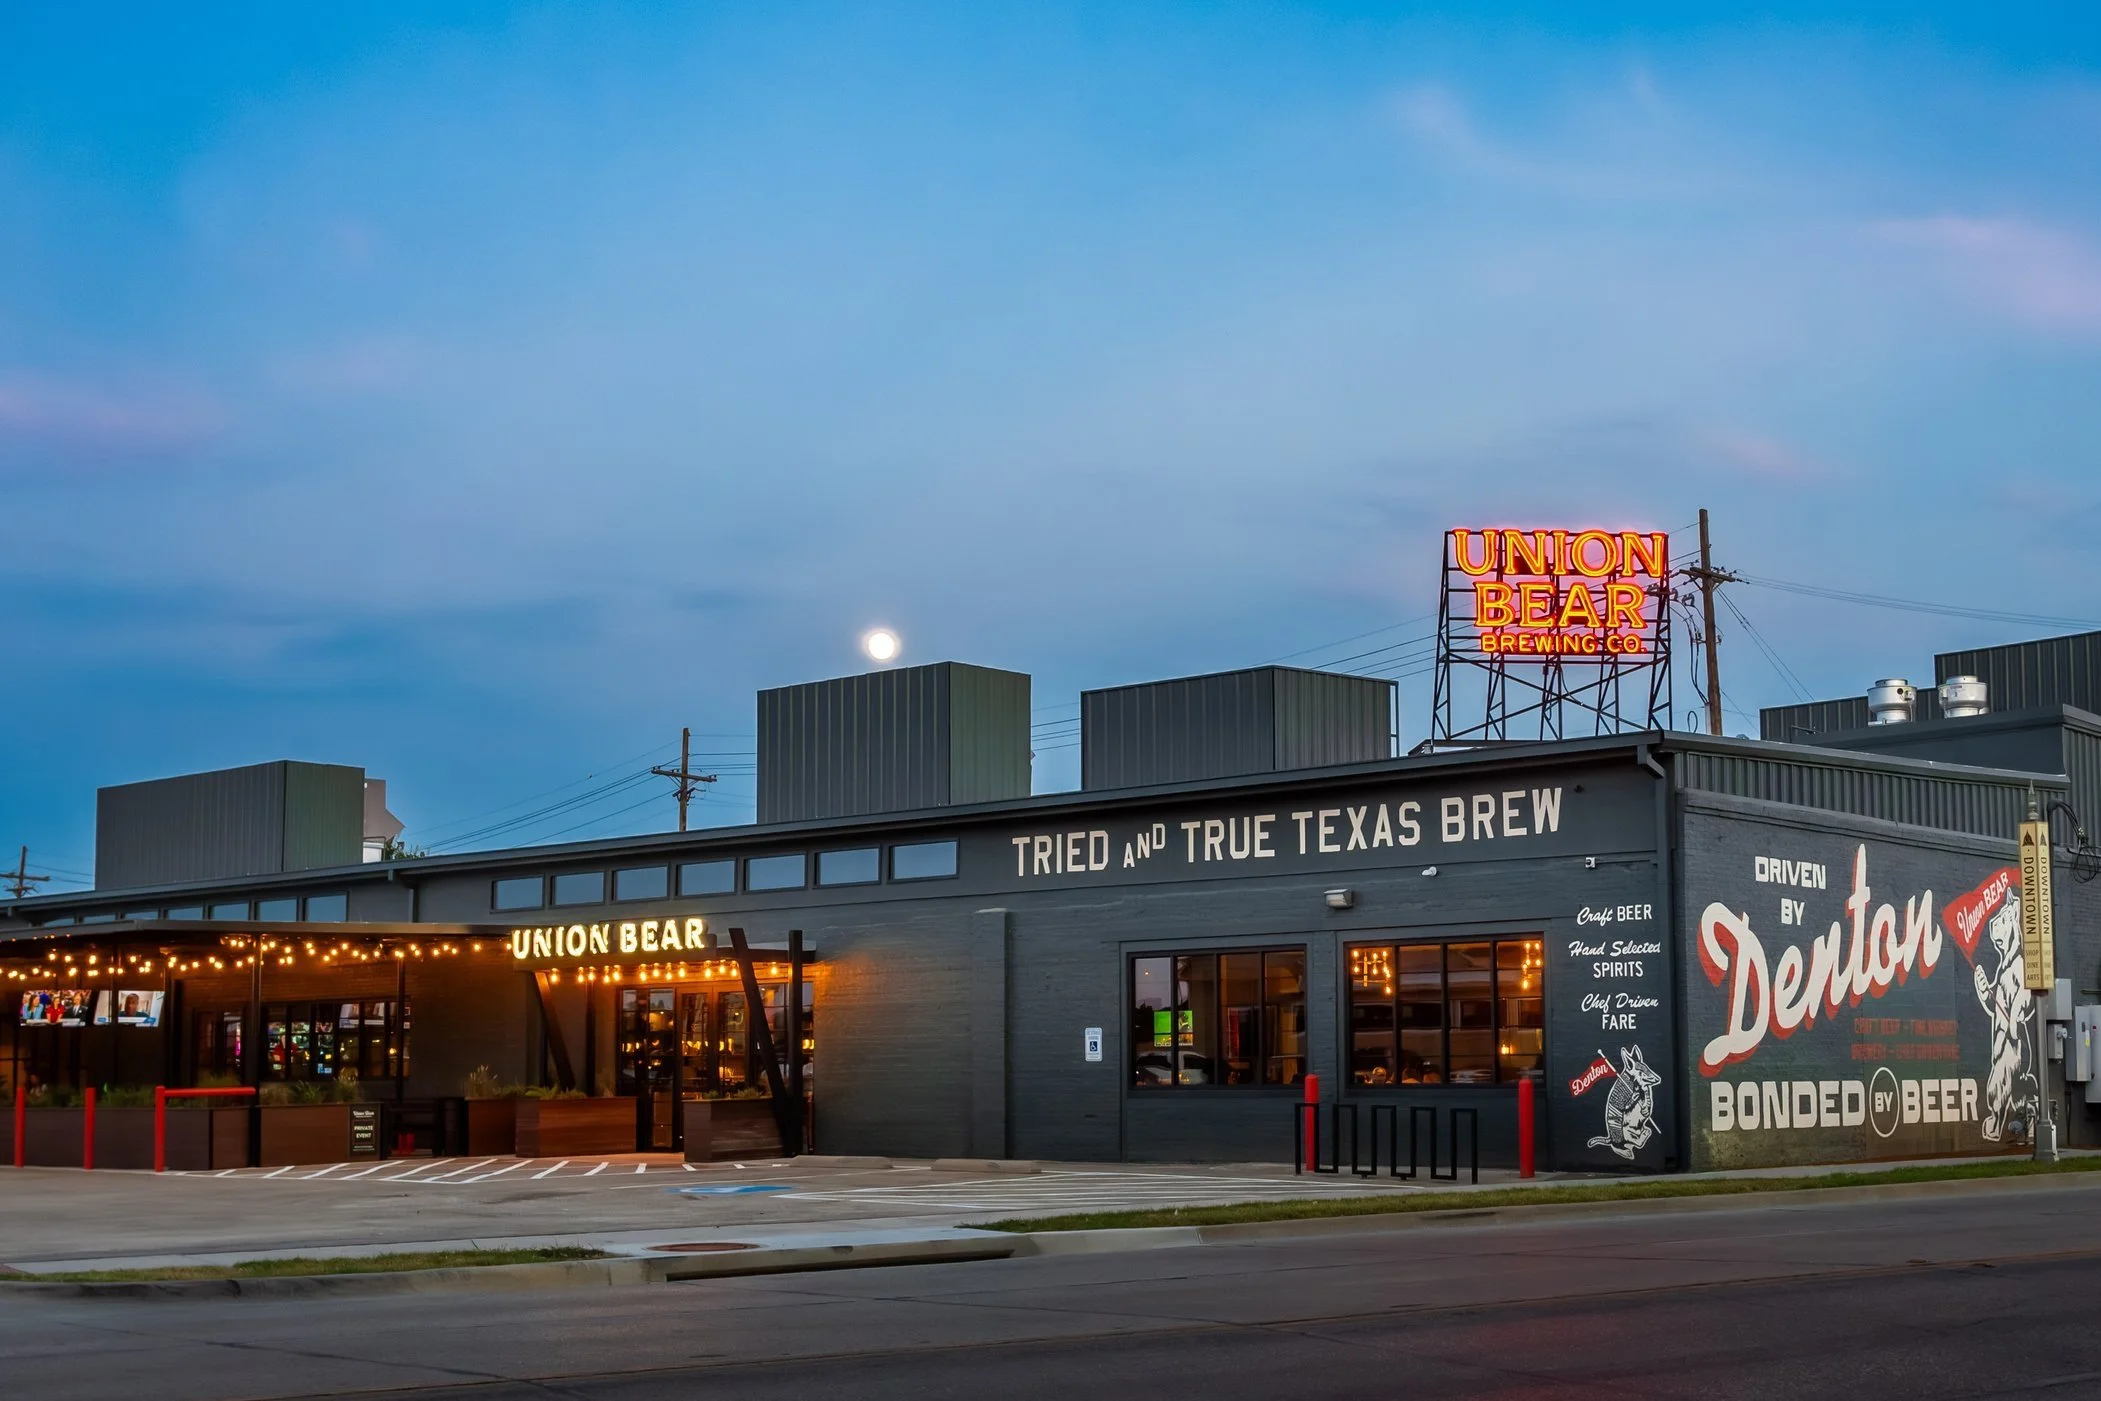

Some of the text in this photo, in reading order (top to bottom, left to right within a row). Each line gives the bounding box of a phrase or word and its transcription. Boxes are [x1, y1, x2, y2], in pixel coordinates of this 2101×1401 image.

[1452, 528, 1665, 577] UNION
[1473, 582, 1648, 628] BEAR
[1481, 632, 1647, 654] BREWING CO.
[1012, 787, 1562, 877] TRIED AND TRUE TEXAS BREW
[1755, 856, 1826, 889] DRIVEN
[1781, 898, 1805, 926] BY
[1957, 872, 2008, 943] Union BEAR
[2023, 857, 2036, 935] DOWNTOWN
[2040, 857, 2050, 935] DOWNTOWN
[1577, 904, 1652, 926] Craft BEER
[511, 918, 706, 959] UNION BEAR
[1568, 940, 1661, 957] Hand Selected
[1699, 844, 1943, 1070] Denton
[1593, 961, 1643, 978] SPIRITS
[1581, 993, 1659, 1013] Chef Driven
[1602, 1014, 1636, 1030] FARE
[1571, 1064, 1608, 1096] Denton
[1711, 1078, 1978, 1131] BONDED BY BEER
